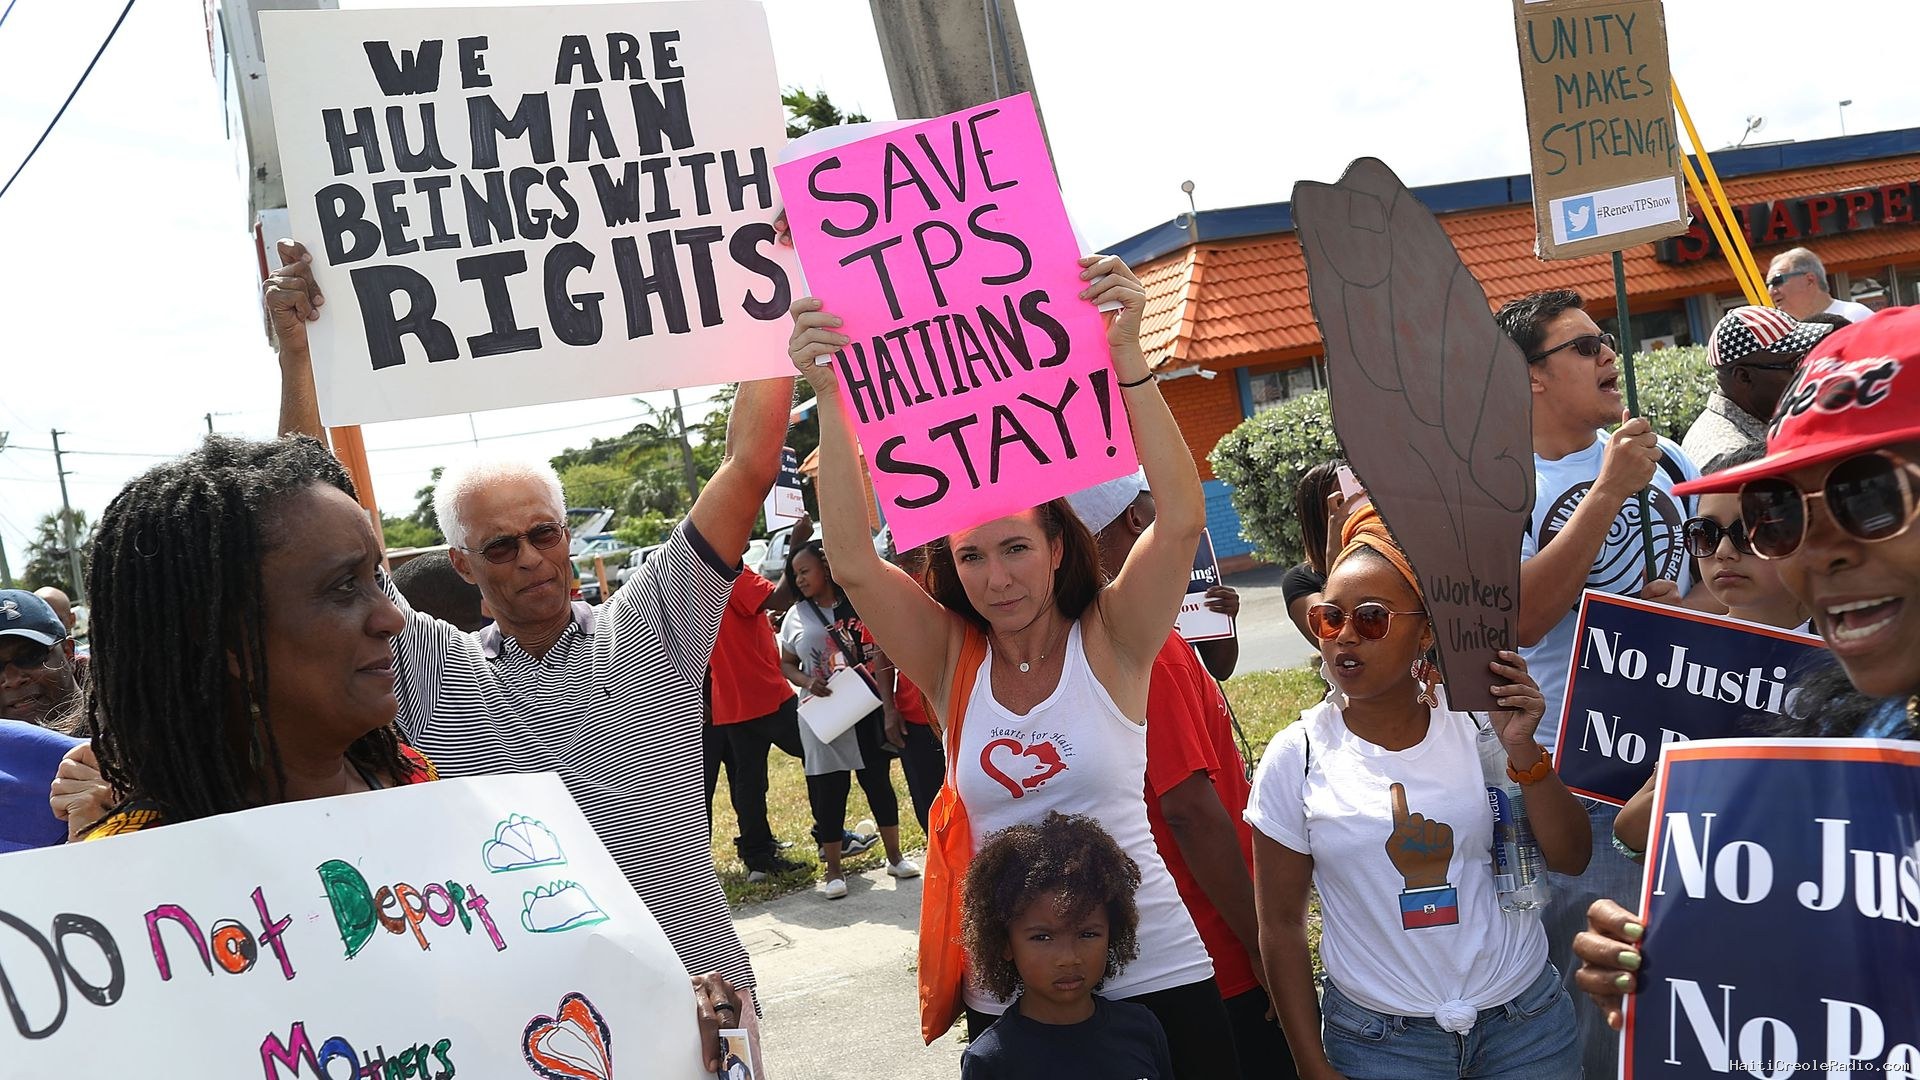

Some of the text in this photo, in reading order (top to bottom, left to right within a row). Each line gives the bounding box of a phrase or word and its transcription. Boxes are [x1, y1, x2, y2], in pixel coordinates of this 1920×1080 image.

[363, 31, 685, 95] WE ARE
[1528, 12, 1636, 64] UNITY
[1555, 63, 1653, 114] MAKES
[322, 80, 695, 176] HUMAN
[315, 147, 773, 266] BEINGS WITH
[808, 109, 1018, 238] SAVE
[1596, 197, 1671, 219] #RenewTPSnow
[349, 223, 791, 370] RIGHTS
[839, 203, 1032, 320] TPS
[834, 289, 1071, 423] HAITIANS
[876, 368, 1116, 509] STAY!
[1665, 524, 1684, 581] PIPELINE
[1430, 574, 1512, 612] Workers
[1449, 614, 1511, 652] United
[1581, 626, 1648, 680] No
[991, 727, 1076, 757] Hearts for Haiti
[1579, 709, 1647, 764] No
[1653, 812, 1774, 904] No
[316, 858, 508, 960] Deport
[1664, 977, 1799, 1080] No
